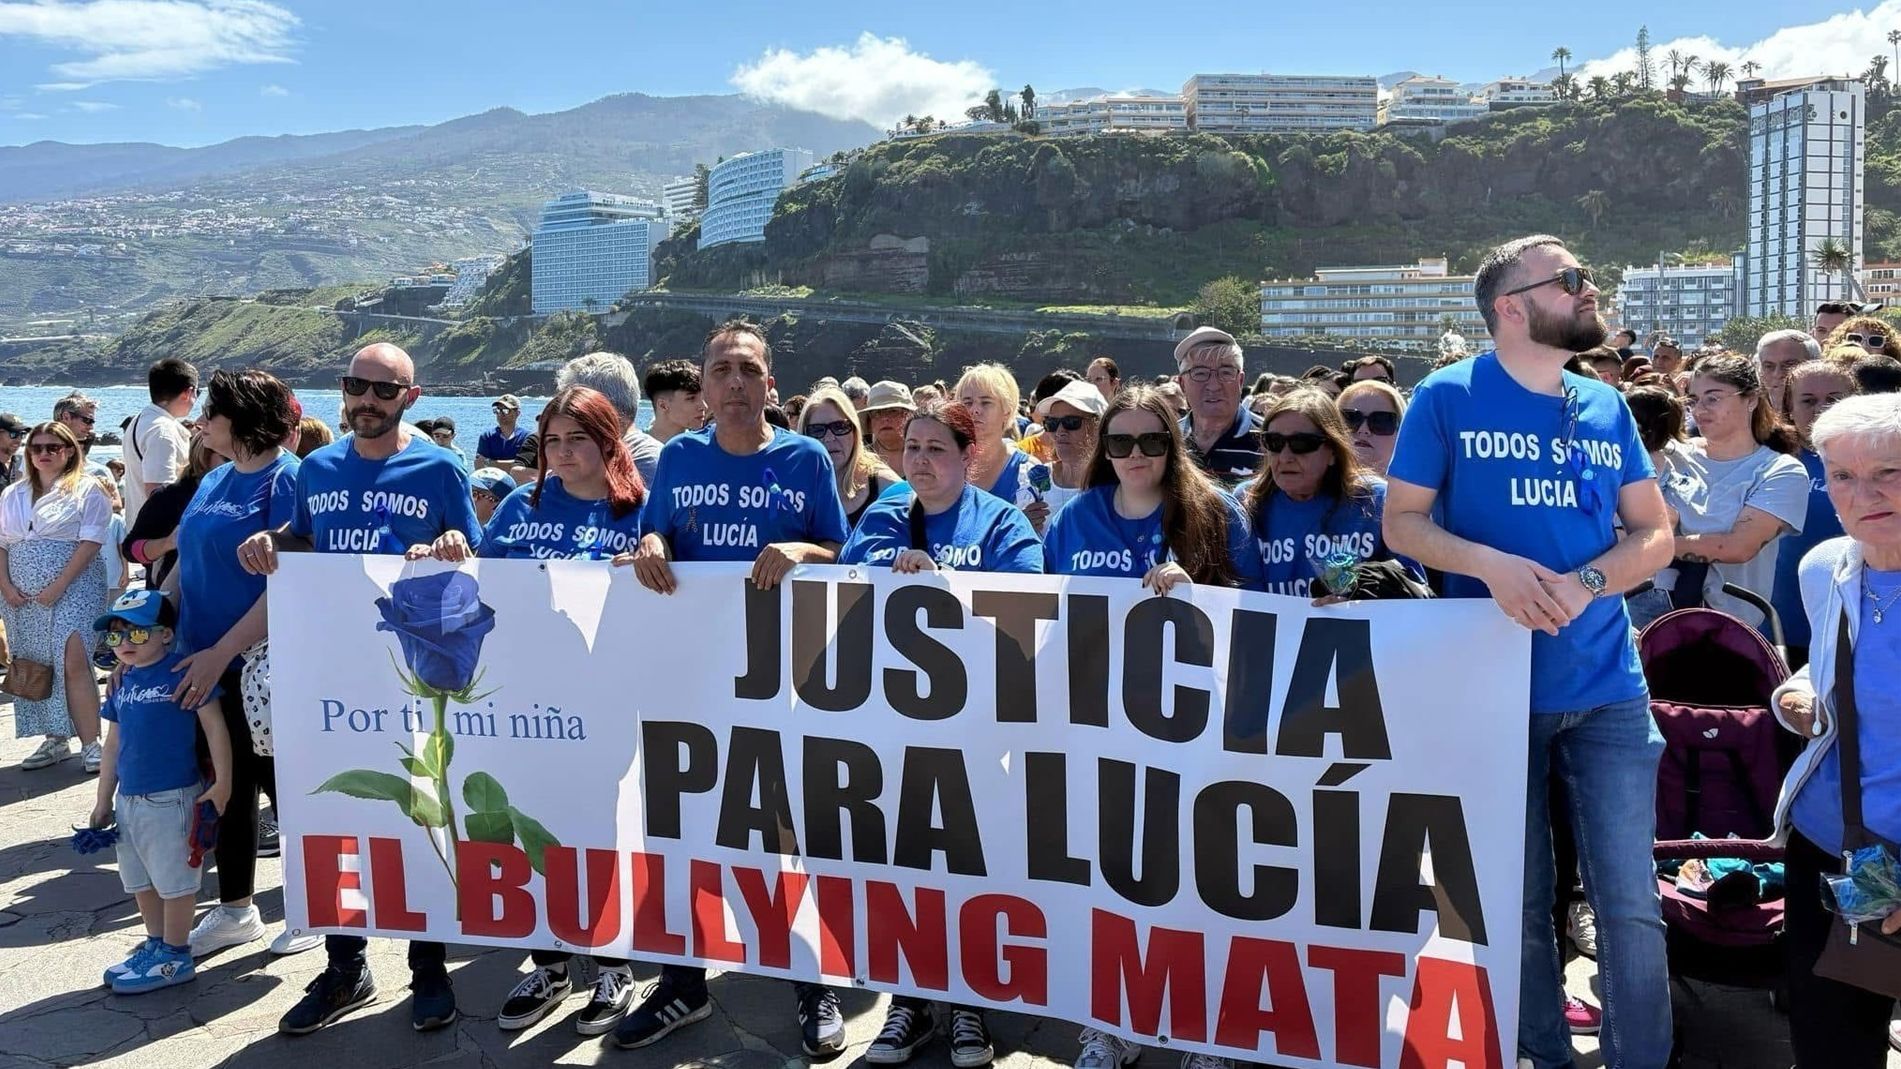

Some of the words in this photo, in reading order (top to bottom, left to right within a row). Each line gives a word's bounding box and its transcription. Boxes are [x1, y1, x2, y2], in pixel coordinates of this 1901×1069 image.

[1460, 431, 1540, 461] TODOS
[672, 483, 730, 509] TODOS
[1511, 470, 1578, 508] LUCÍA
[307, 490, 350, 515] TODOS
[361, 490, 428, 519] SOMOS
[329, 522, 380, 551] LUCÍA
[508, 522, 564, 541] TODOS
[572, 525, 638, 553] SOMOS
[703, 516, 758, 547] LUCÍA
[1305, 532, 1374, 559] SOMOS
[933, 543, 982, 567] SOMO
[1072, 549, 1132, 571] TODOS
[735, 577, 1392, 760] JUSTICIA
[320, 698, 389, 733] Por
[400, 699, 424, 733] ti
[453, 701, 499, 738] mi
[508, 703, 587, 741] niña
[641, 720, 988, 878] PARA
[1025, 752, 1489, 947] LUCÍA
[302, 834, 427, 933] EL
[456, 840, 1048, 1008] BULLYING
[1090, 907, 1502, 1069] MATA
